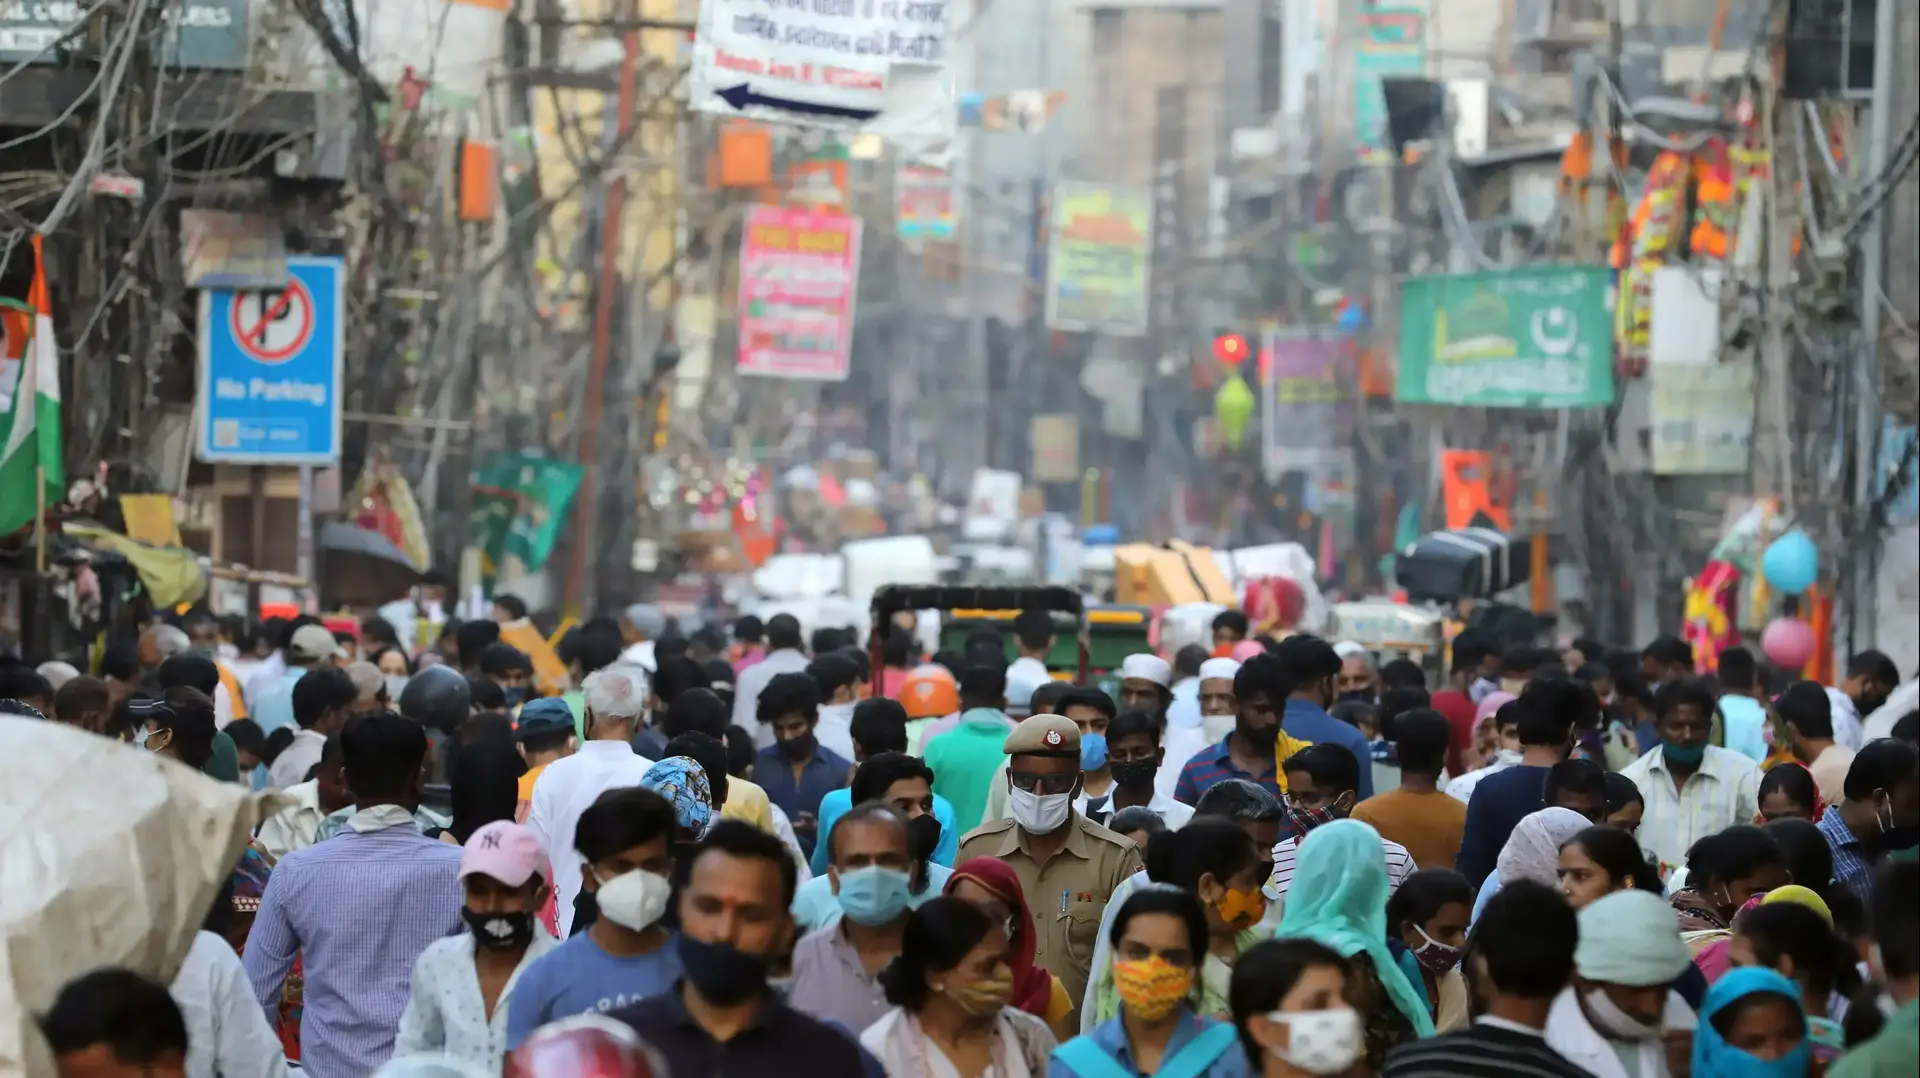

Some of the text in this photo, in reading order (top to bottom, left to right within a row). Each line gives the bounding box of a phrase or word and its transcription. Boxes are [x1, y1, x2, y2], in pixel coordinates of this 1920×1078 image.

[217, 377, 326, 407] No Parking
[481, 831, 503, 849] NY
